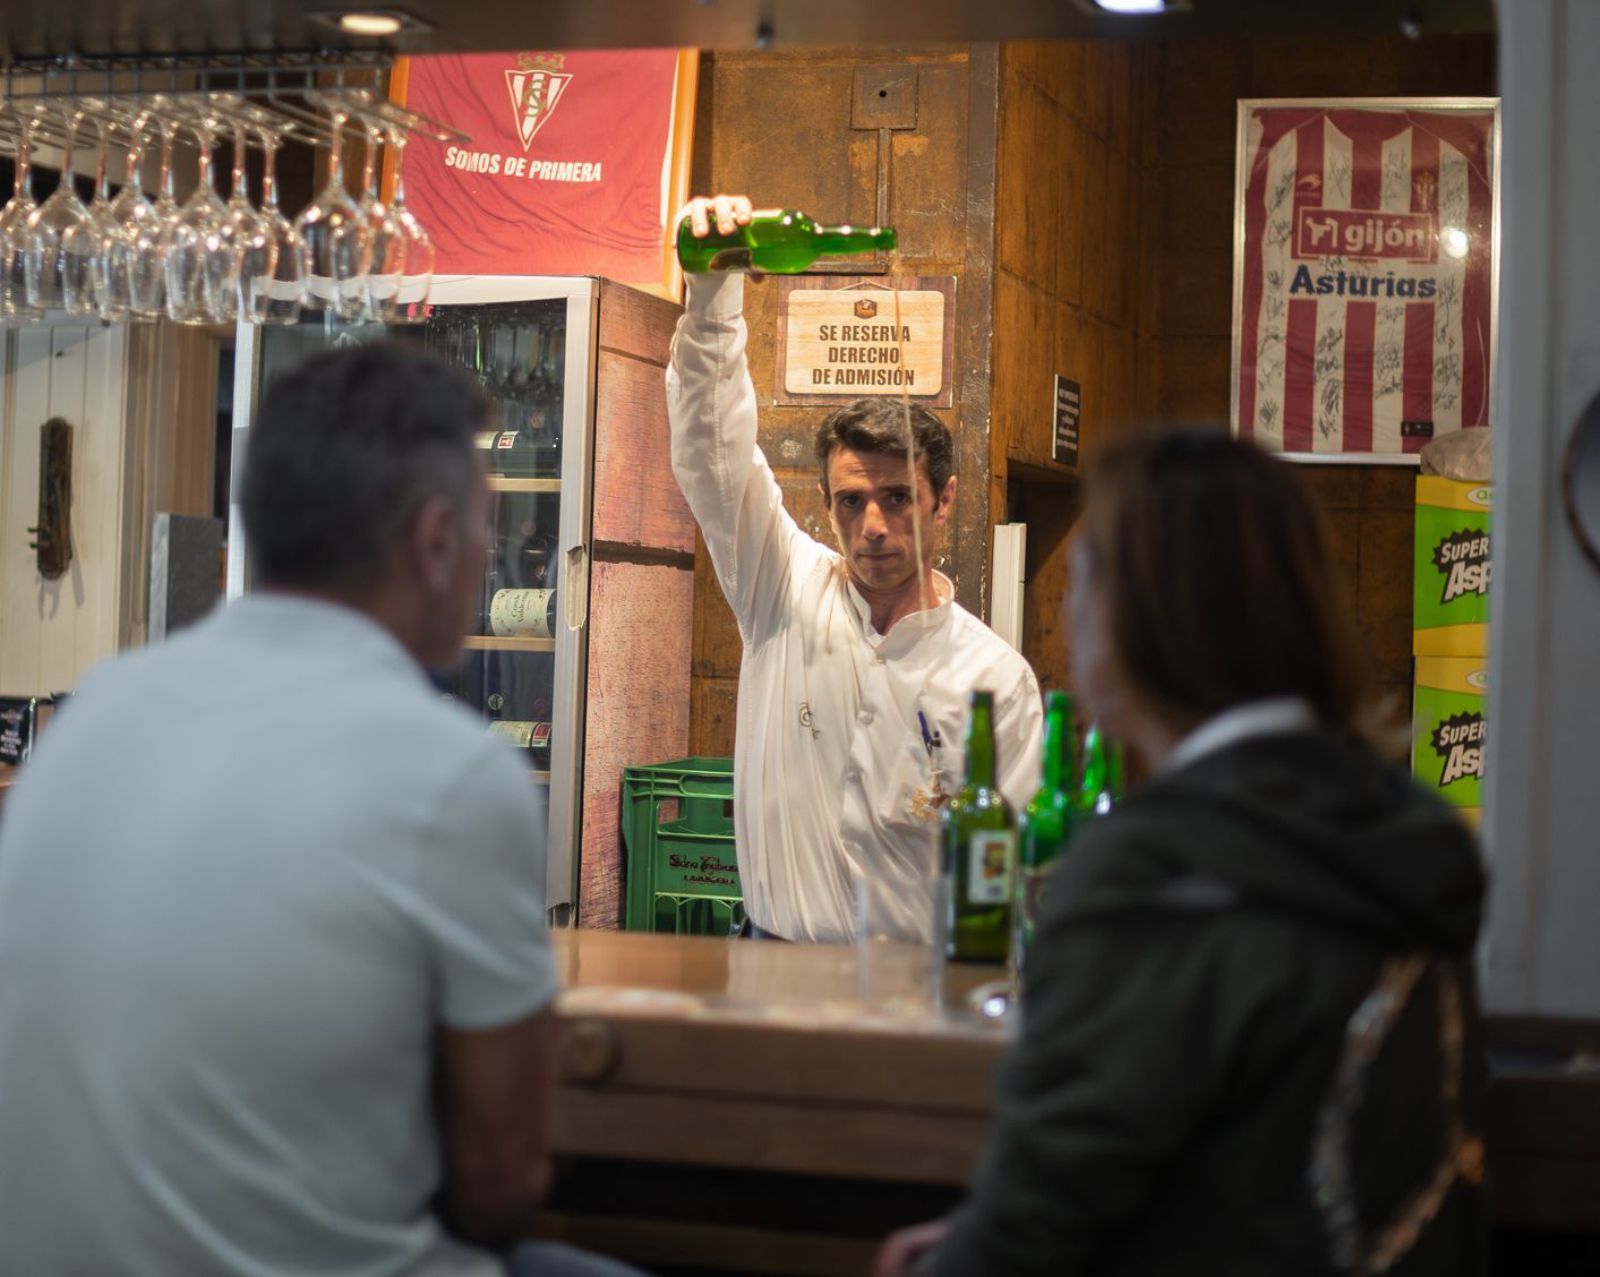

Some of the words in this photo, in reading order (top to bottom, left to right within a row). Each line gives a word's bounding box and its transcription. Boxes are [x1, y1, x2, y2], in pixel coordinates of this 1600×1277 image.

[445, 146, 501, 174] SOMOS
[504, 157, 527, 177] DE
[529, 160, 602, 182] PRIMERA
[1345, 219, 1425, 253] gijón
[1289, 263, 1437, 298] Asturias
[819, 324, 837, 341] SE
[841, 325, 911, 341] RESERVA
[828, 347, 900, 363] DERECHO
[812, 368, 831, 385] DE
[835, 365, 915, 386] ADMISIÓN
[1440, 537, 1489, 564] SUPER
[1438, 721, 1487, 747] SUPER
